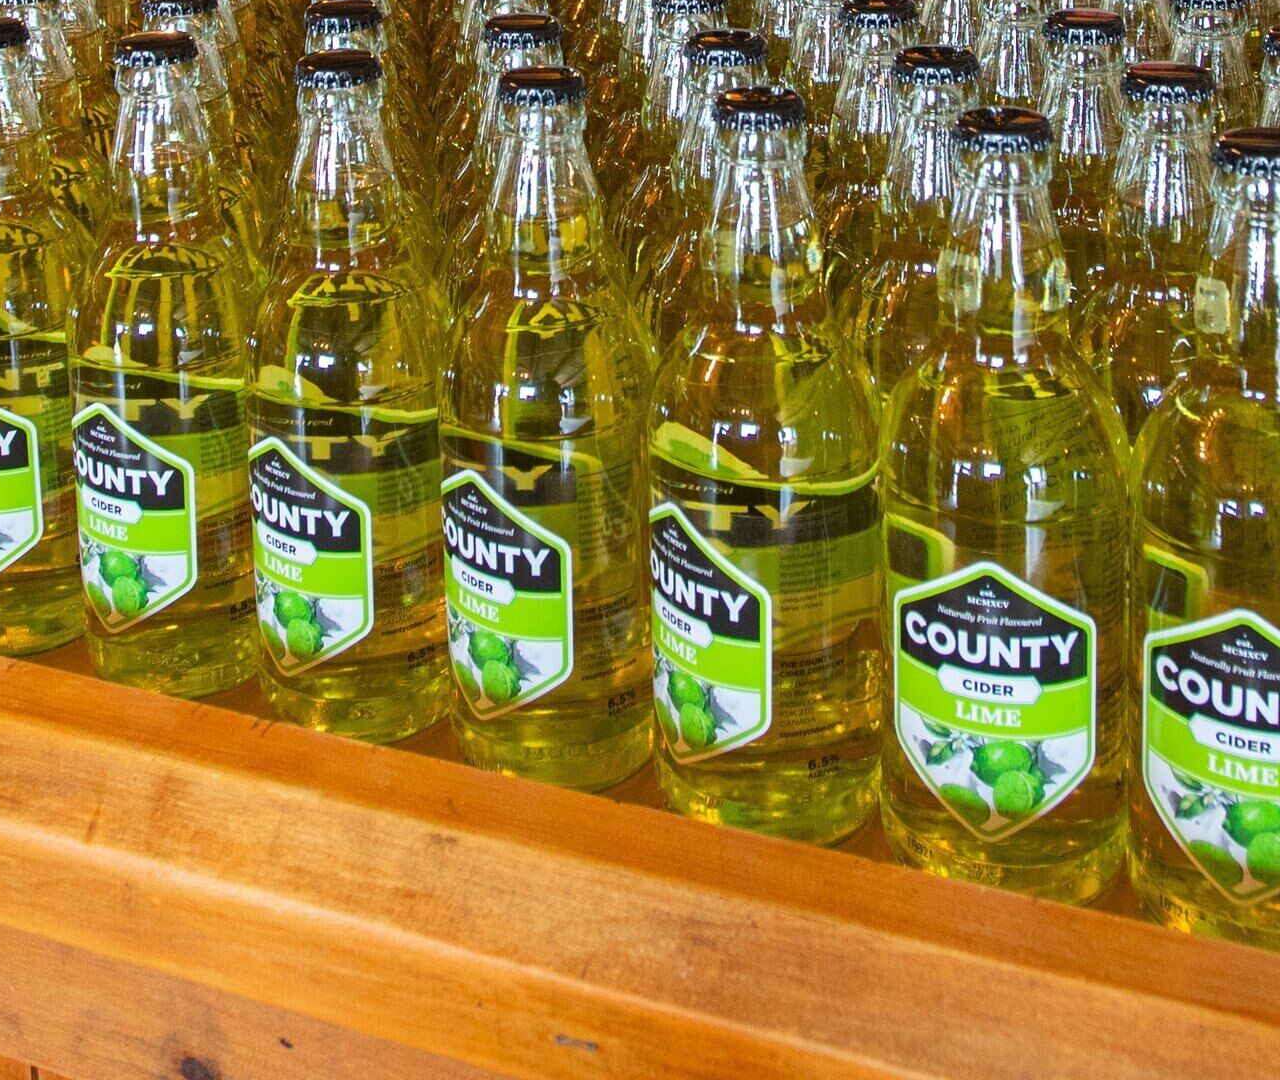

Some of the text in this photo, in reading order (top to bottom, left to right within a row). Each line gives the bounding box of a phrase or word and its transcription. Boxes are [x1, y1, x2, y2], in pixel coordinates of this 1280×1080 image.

[73, 441, 174, 496] OUNTY
[91, 497, 122, 515] CIDER
[250, 474, 350, 537] OUNTY
[90, 515, 128, 541] LIME
[266, 534, 296, 555] CIDER
[441, 507, 550, 577] OUNTY
[264, 556, 302, 582] LIME
[461, 571, 493, 594] CIDER
[650, 548, 750, 623] OUNTY
[979, 590, 996, 598] est.
[458, 590, 500, 623] LIME
[937, 604, 1042, 626] Naturally Fruit Flavoured
[967, 596, 1010, 609] MCMXCV
[662, 606, 692, 634] CIDER
[659, 626, 698, 665] LIME
[905, 610, 1079, 669] COUNTY
[1222, 644, 1268, 661] MCMXCV
[1235, 639, 1253, 648] est.
[1190, 651, 1231, 675] Naturally
[1232, 663, 1255, 678] Fruit
[963, 679, 1013, 697] CIDER
[956, 701, 1021, 727] LIME
[1216, 732, 1271, 754] CIDER
[1208, 754, 1278, 786] LIME
